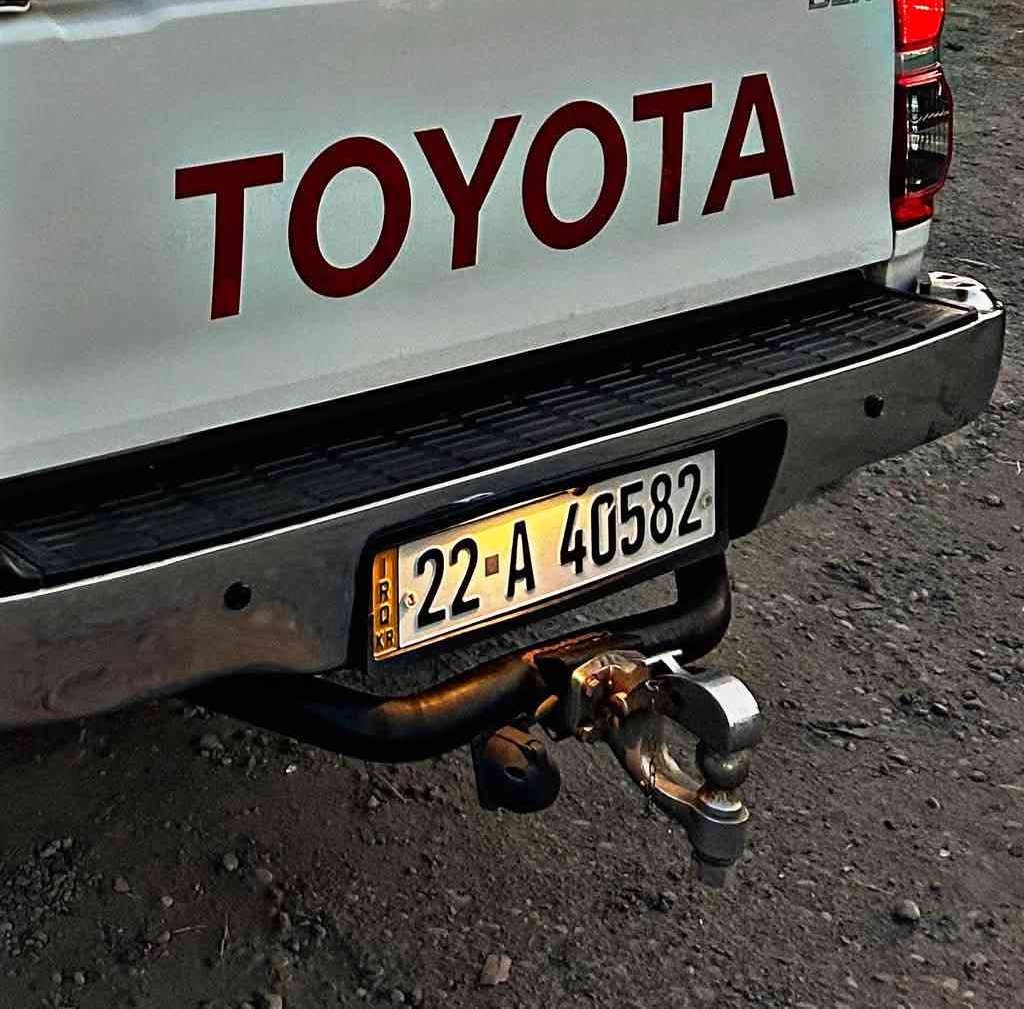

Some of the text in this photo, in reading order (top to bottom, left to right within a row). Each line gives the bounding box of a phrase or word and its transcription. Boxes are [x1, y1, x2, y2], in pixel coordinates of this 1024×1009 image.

[175, 72, 795, 320] TOYOTA
[416, 463, 702, 627] 22 A 40582
